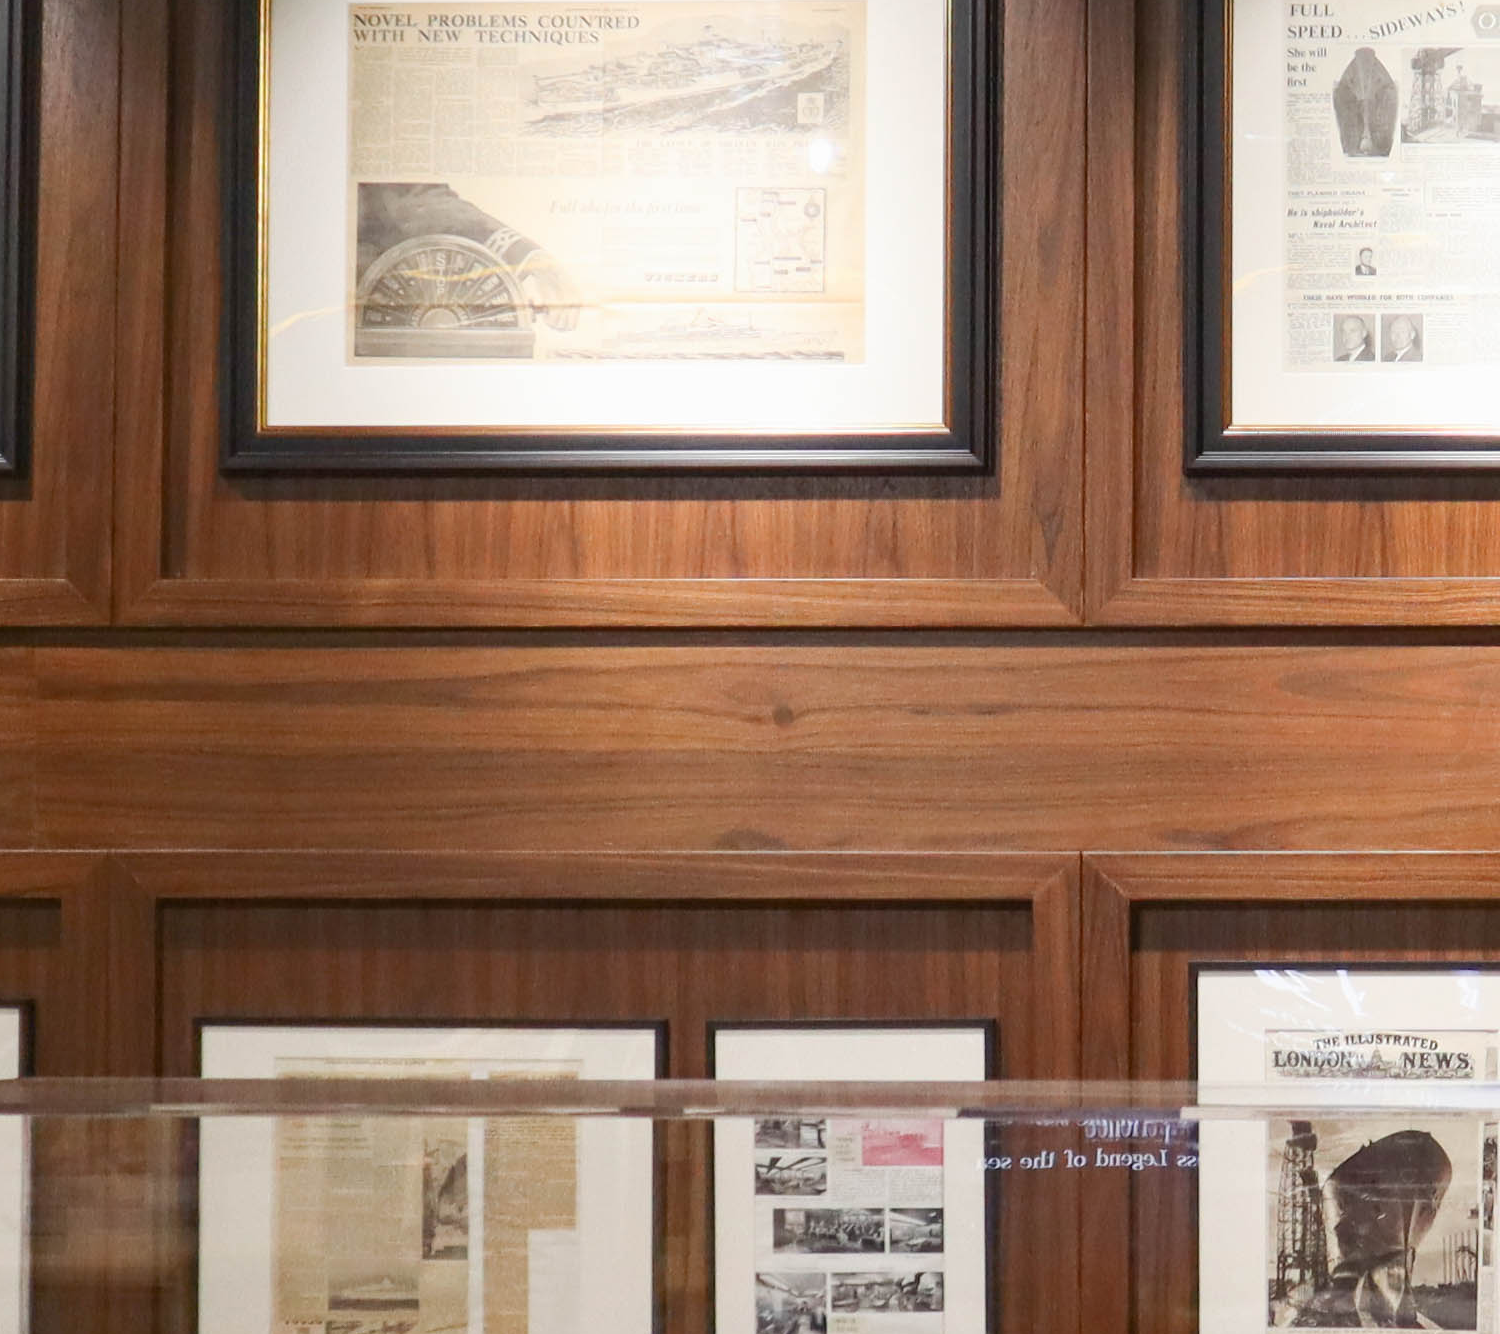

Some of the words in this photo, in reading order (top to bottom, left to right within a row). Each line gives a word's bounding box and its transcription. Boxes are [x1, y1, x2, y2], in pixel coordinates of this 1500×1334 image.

[1290, 3, 1334, 17] FULL
[354, 14, 419, 27] NOVEL
[427, 15, 527, 27] PROBLEMS
[355, 30, 404, 42] WITH
[418, 30, 461, 42] NEW
[476, 30, 600, 45] TECHNIQUES
[1287, 25, 1342, 39] SPEED
[1287, 48, 1306, 58] She
[1309, 48, 1327, 58] will
[1287, 63, 1298, 73] be
[1301, 63, 1316, 73] the
[1287, 77, 1307, 87] first
[1314, 1037, 1340, 1051] THE
[1345, 1034, 1439, 1051] ILLUSTRATED
[1273, 1051, 1352, 1068] LONDON
